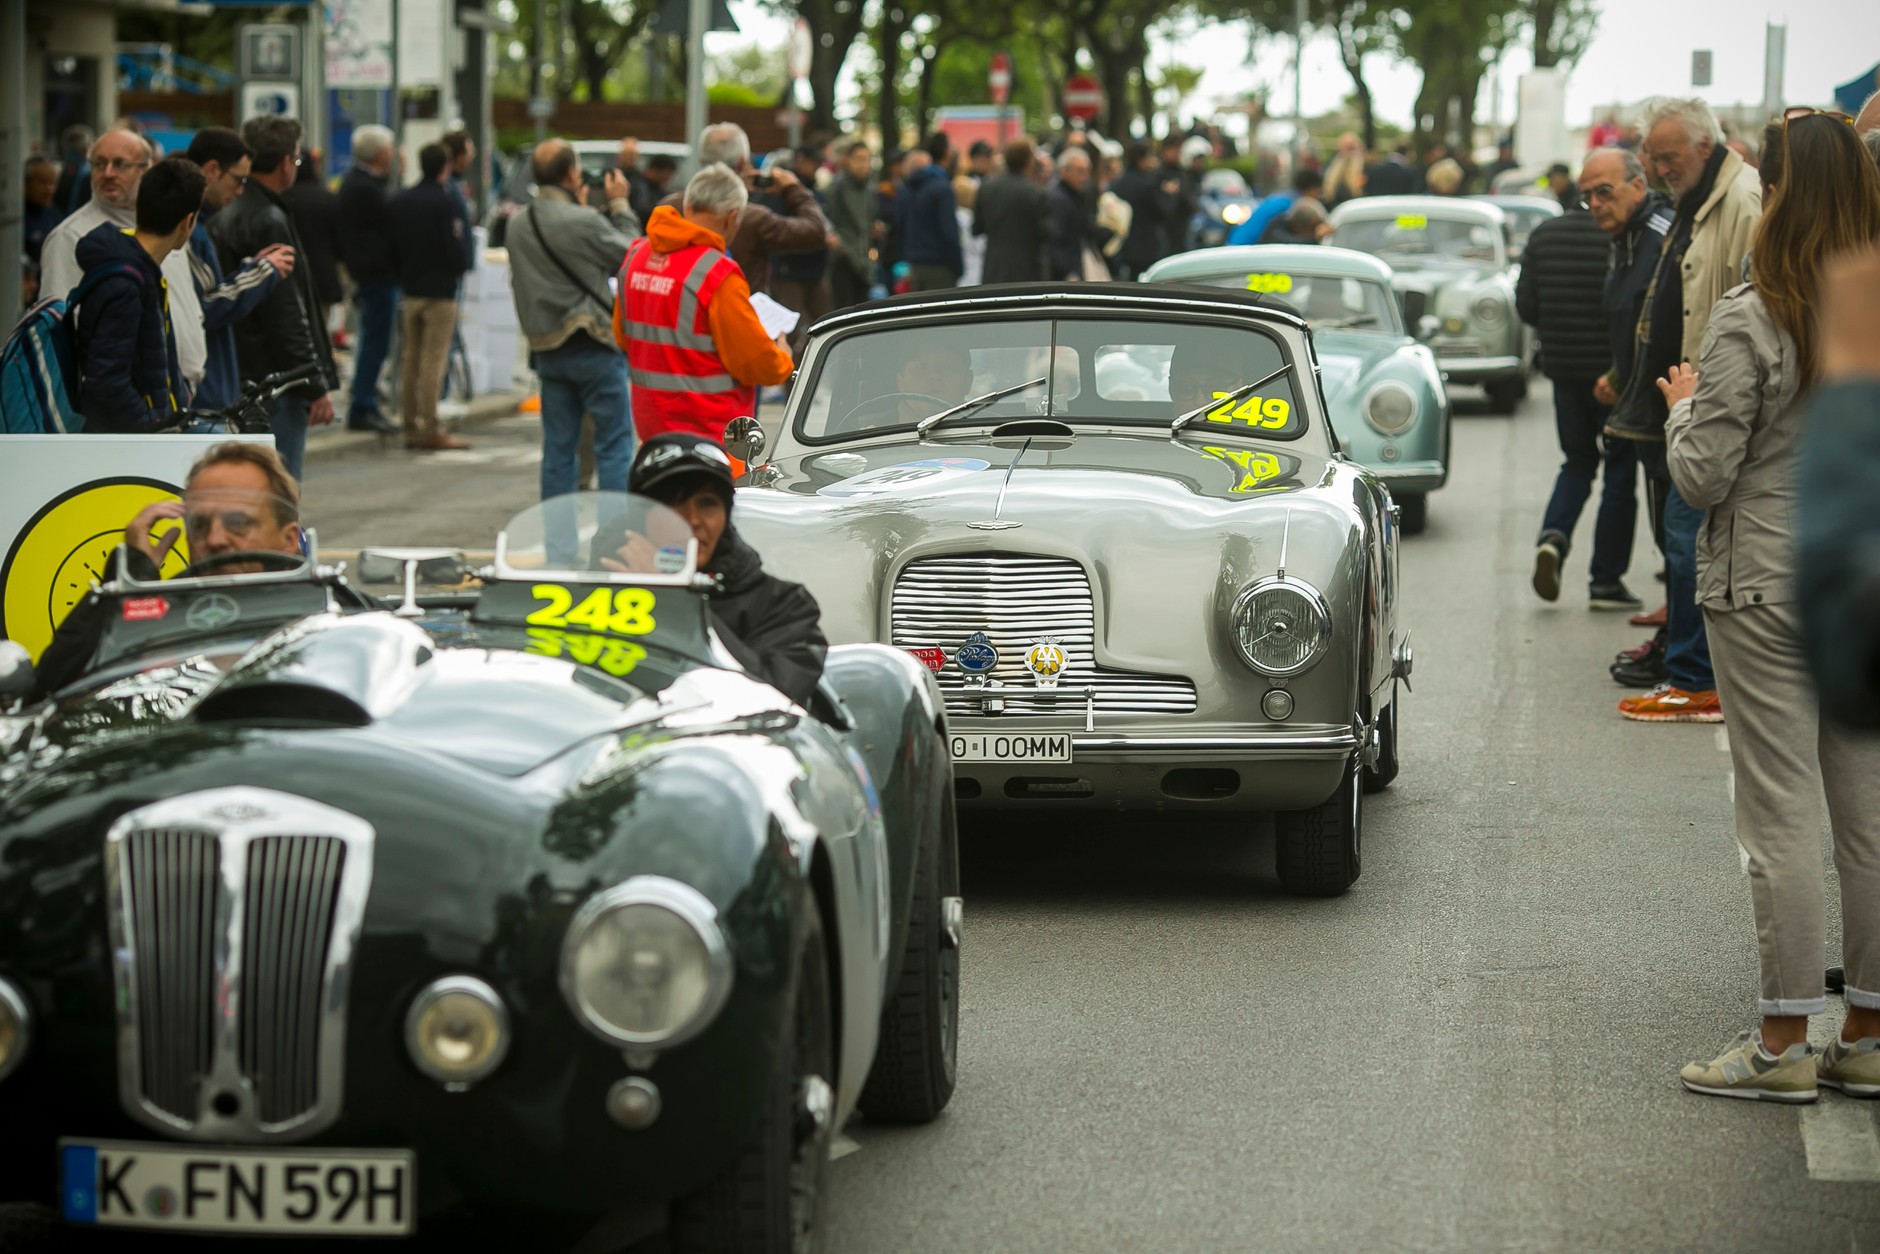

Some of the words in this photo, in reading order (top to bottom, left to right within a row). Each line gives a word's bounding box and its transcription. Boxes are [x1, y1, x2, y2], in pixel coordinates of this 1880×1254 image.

[630, 271, 652, 292] POST
[649, 275, 676, 296] CHIEF
[1207, 391, 1290, 429] 249
[525, 583, 656, 635] 248
[101, 1156, 138, 1217] K
[182, 1161, 265, 1223] FN
[283, 1164, 402, 1225] 59H
